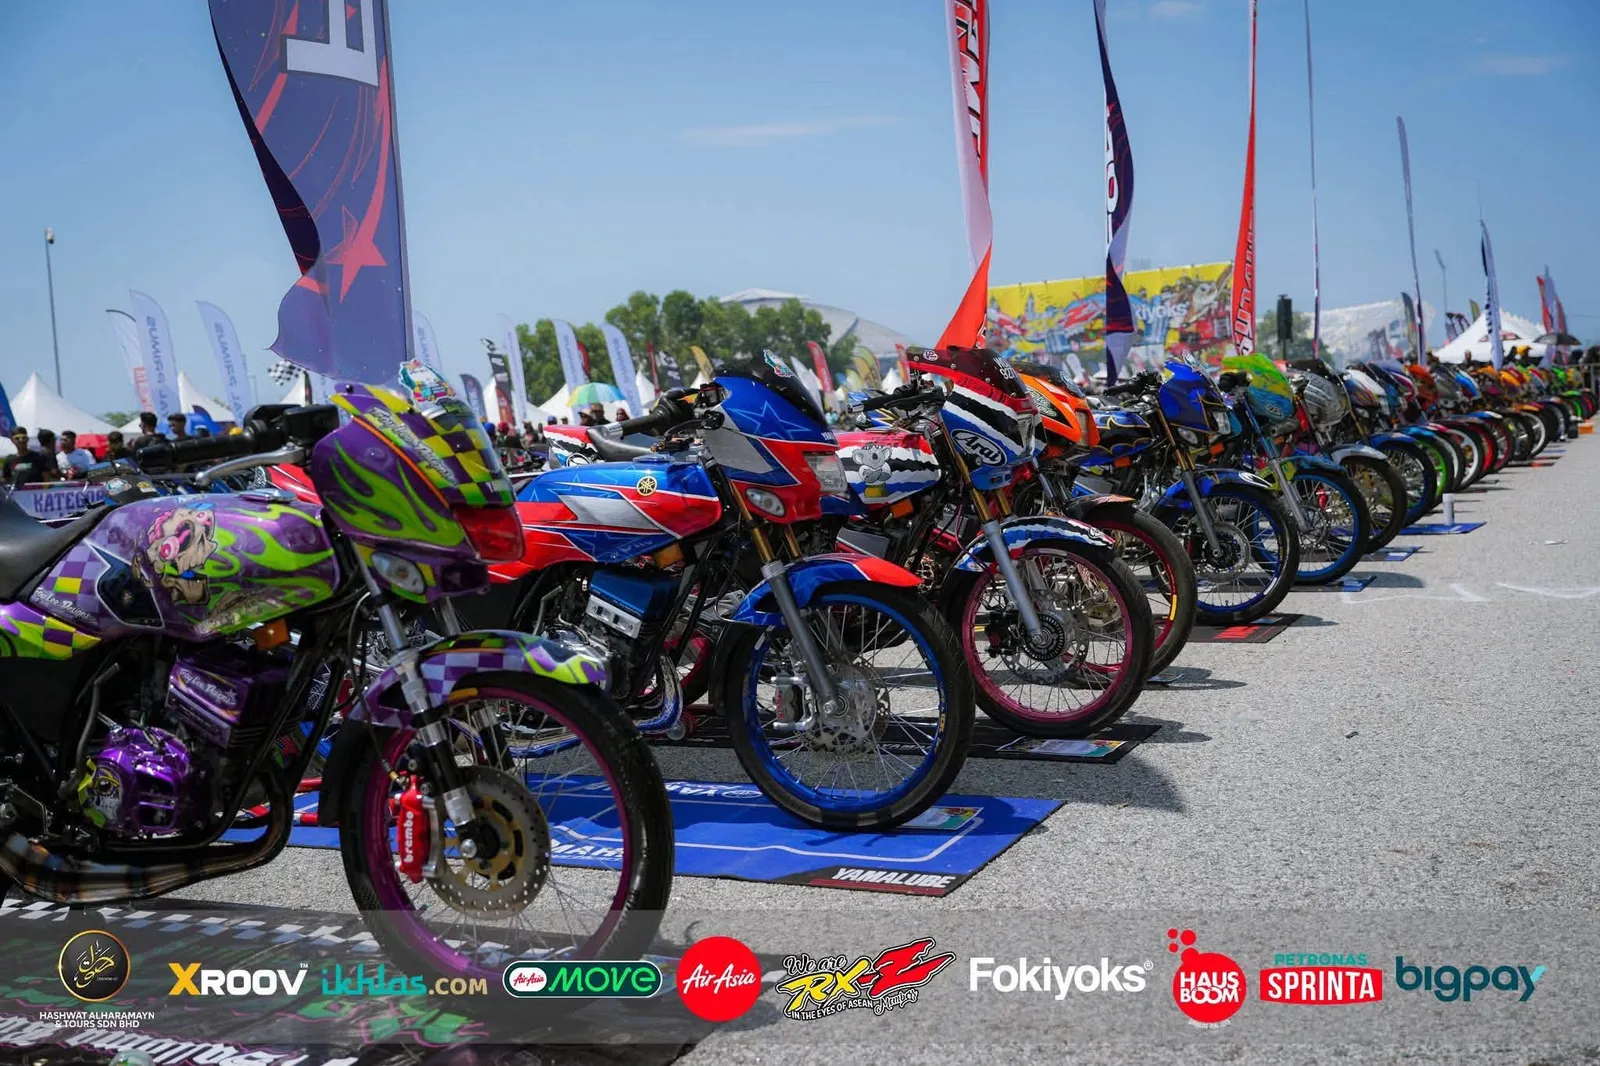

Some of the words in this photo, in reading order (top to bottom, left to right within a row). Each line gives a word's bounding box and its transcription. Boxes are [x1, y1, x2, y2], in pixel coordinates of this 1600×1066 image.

[955, 435, 1003, 462] Arai
[403, 811, 414, 863] brembo
[832, 868, 956, 888] YAMALUBE
